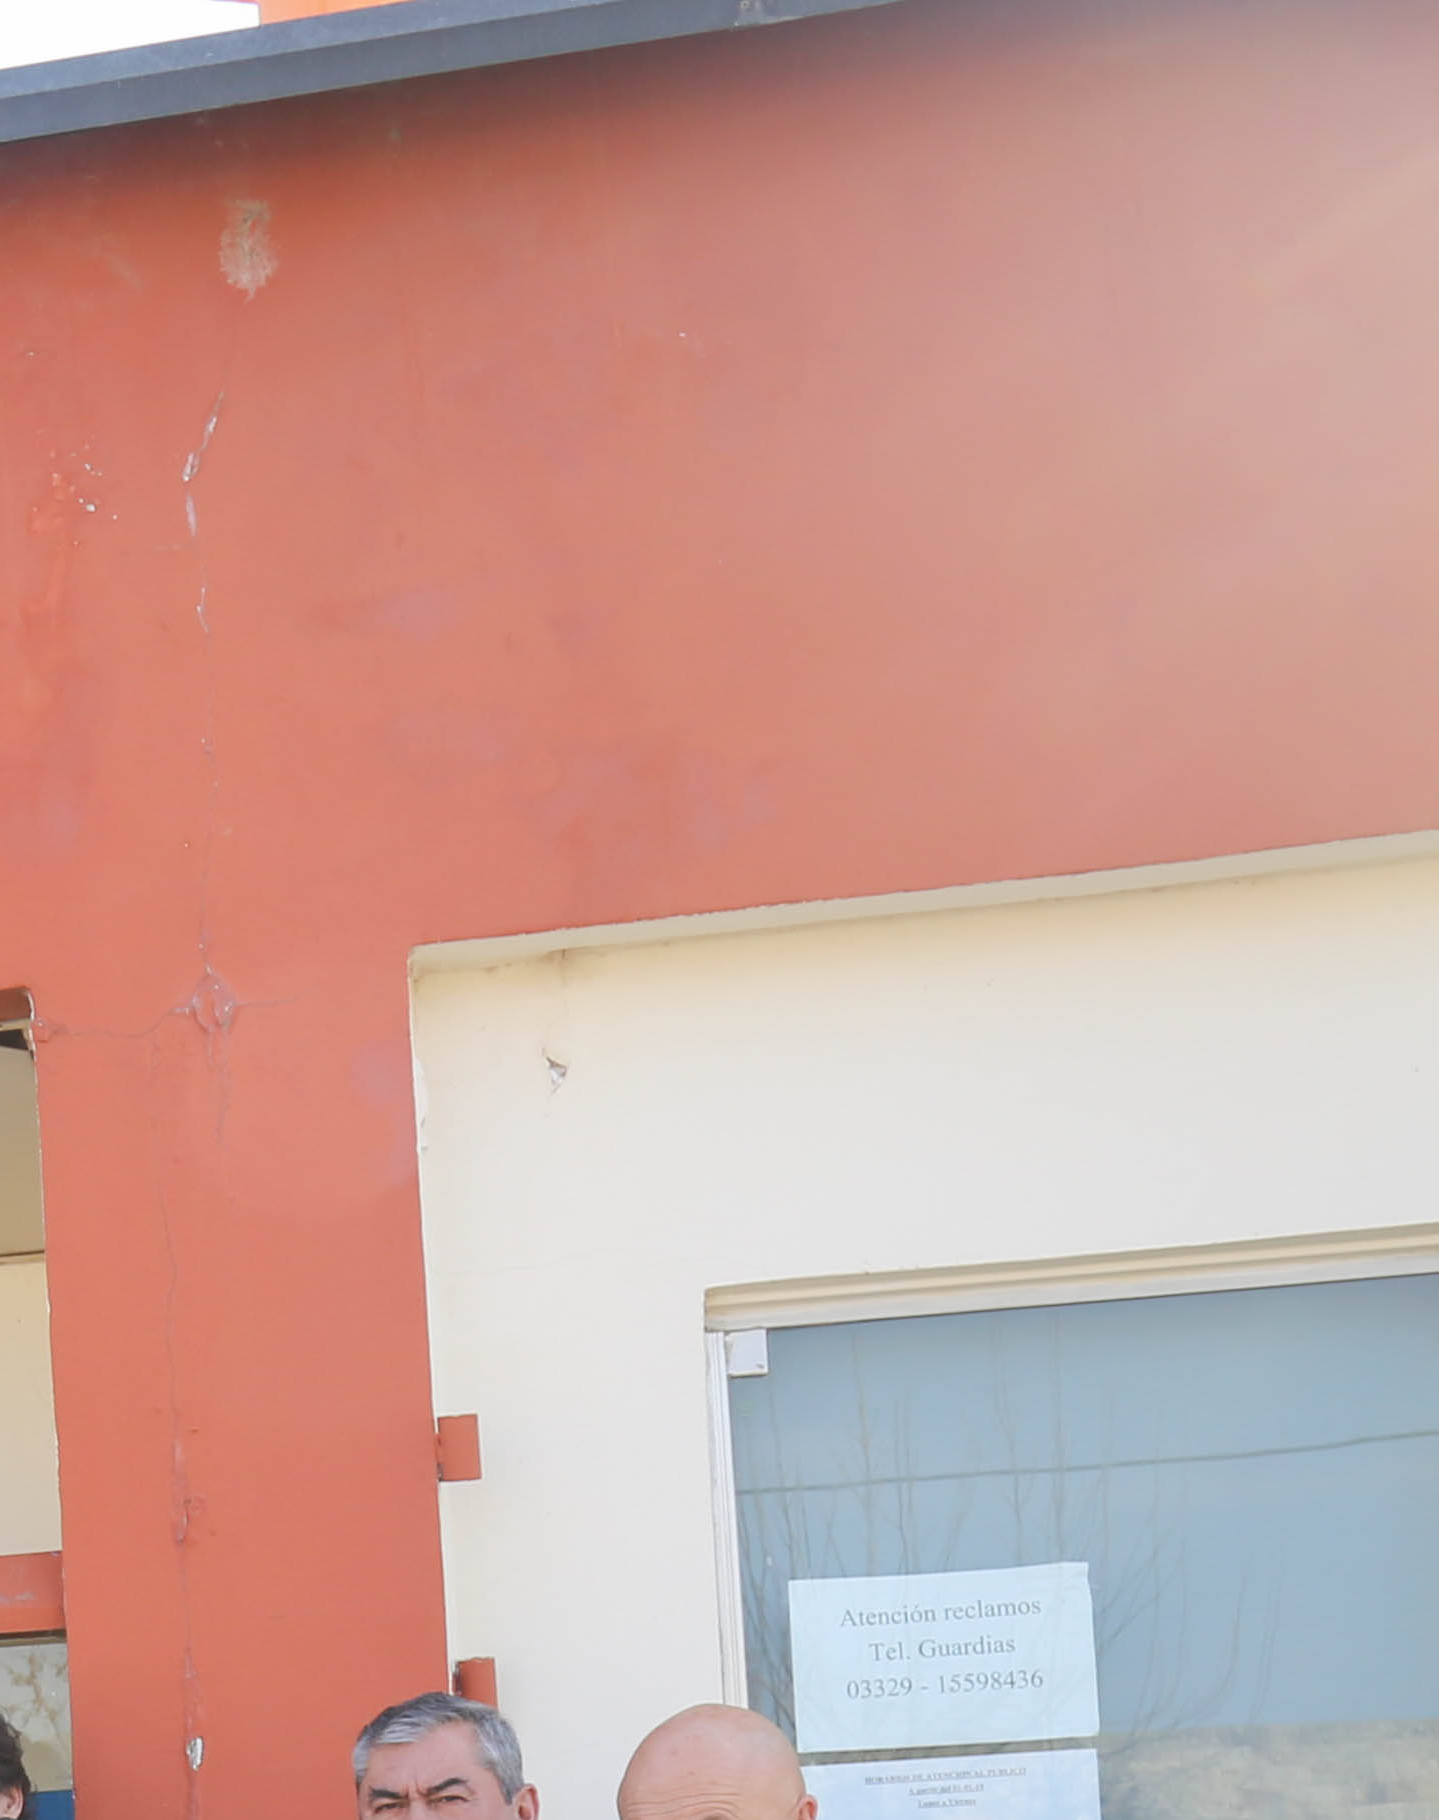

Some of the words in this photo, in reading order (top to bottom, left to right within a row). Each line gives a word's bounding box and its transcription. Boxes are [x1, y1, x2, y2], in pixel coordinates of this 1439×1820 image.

[840, 1604, 936, 1628] Atención
[944, 1598, 1041, 1621] reclamos
[868, 1641, 911, 1662] Tel.
[918, 1634, 1017, 1659] Guardias
[846, 1676, 913, 1700] 03329
[939, 1668, 1044, 1695] 15598436
